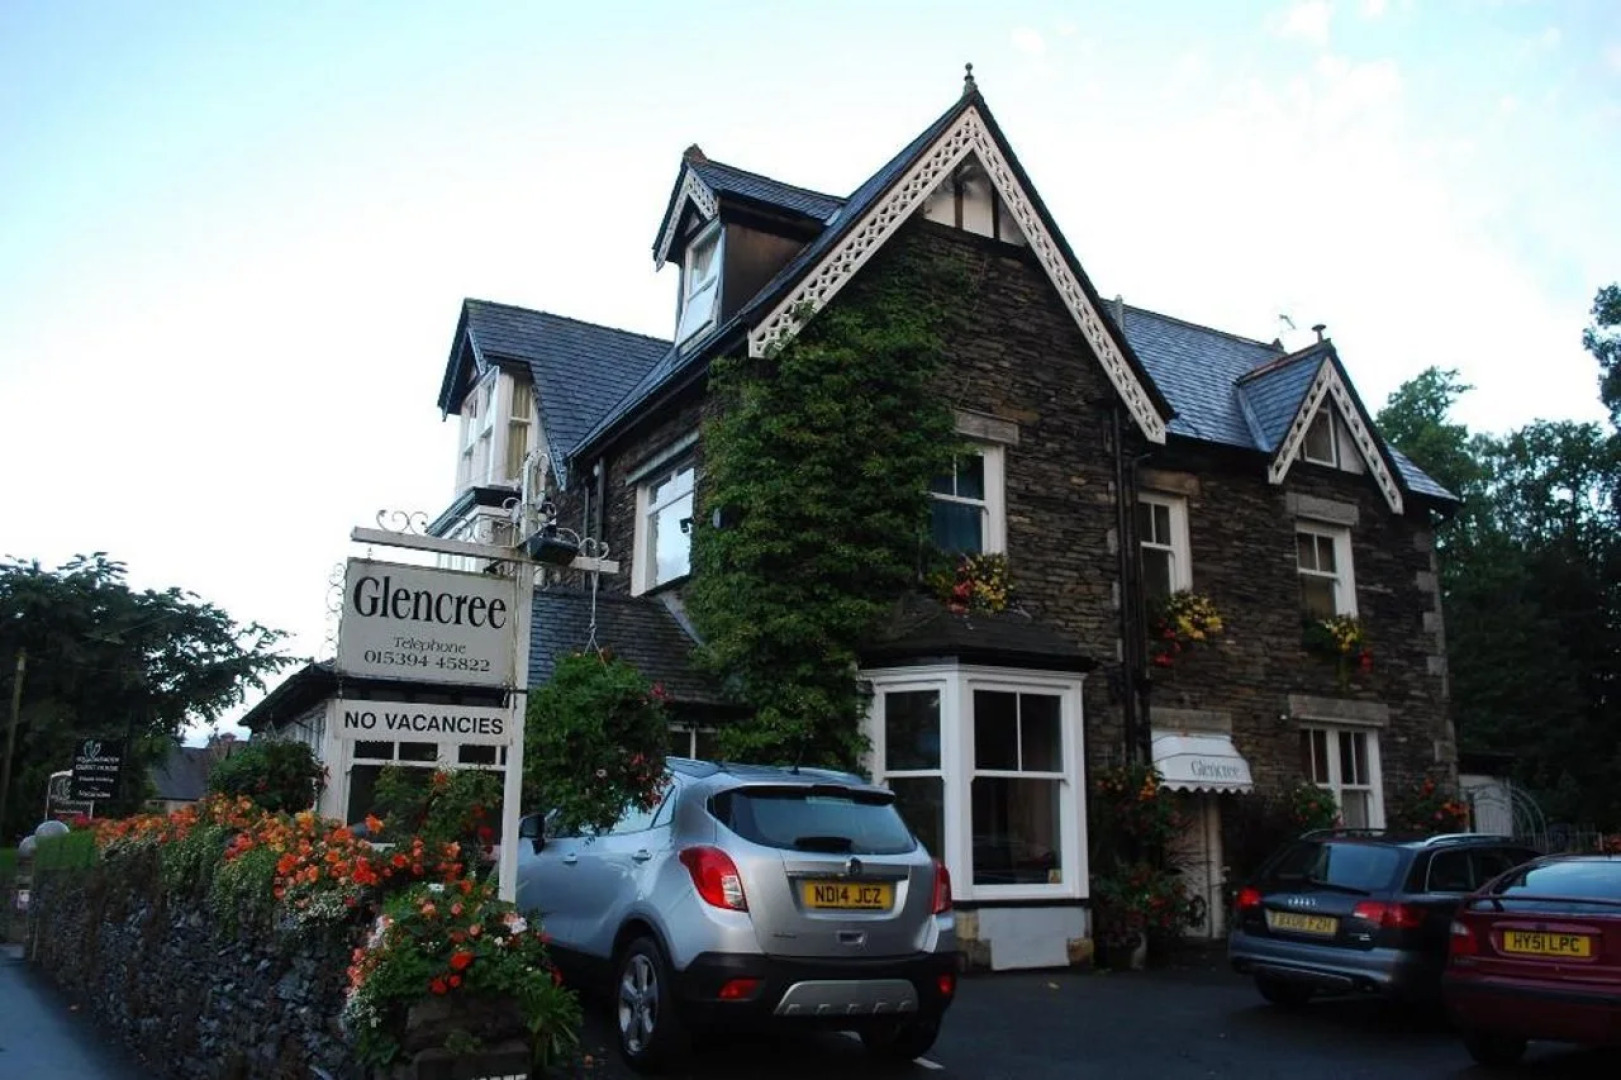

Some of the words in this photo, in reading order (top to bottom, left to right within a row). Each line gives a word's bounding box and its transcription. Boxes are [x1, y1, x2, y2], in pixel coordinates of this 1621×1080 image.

[353, 576, 507, 629] Glencree
[394, 637, 467, 654] Telephone
[364, 650, 428, 667] 015394
[436, 657, 490, 672] 45822
[345, 711, 377, 730] NO
[385, 713, 504, 735] VACANCIES
[1191, 760, 1238, 779] Glencree
[814, 885, 850, 903] ND14
[854, 887, 882, 904] JCZ
[1514, 932, 1546, 951] HY51
[1549, 934, 1580, 953] LPC
